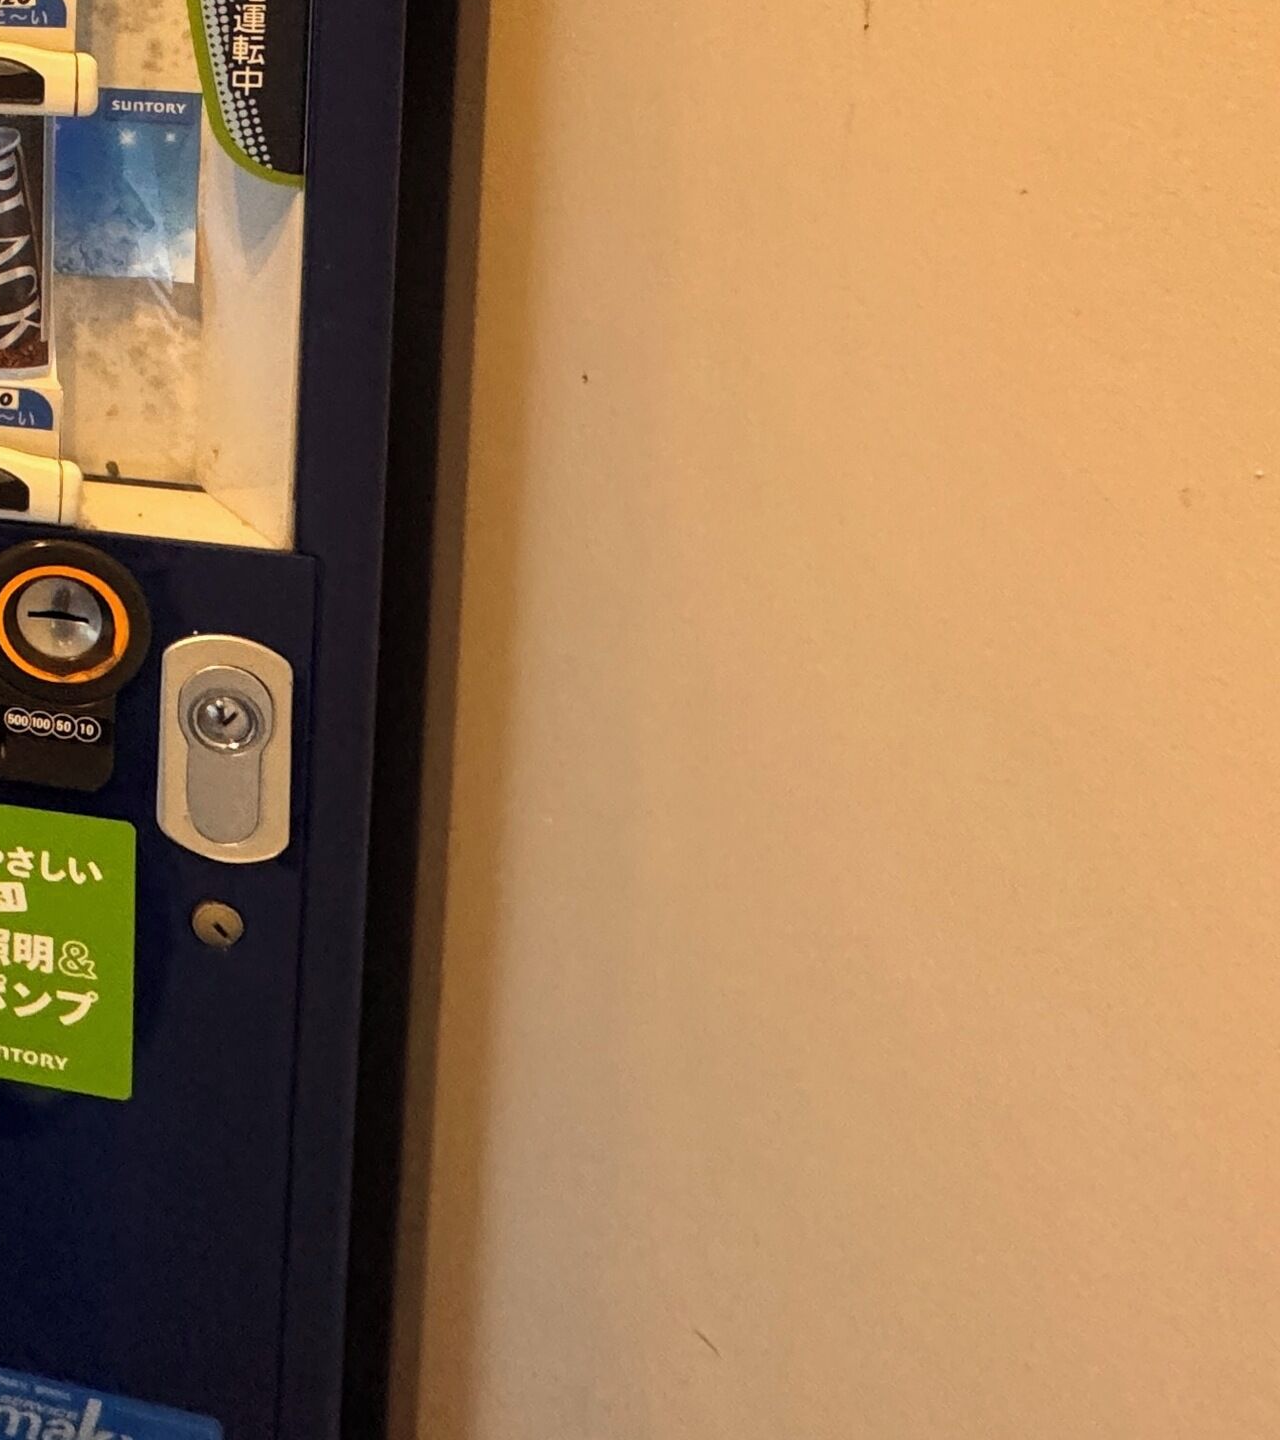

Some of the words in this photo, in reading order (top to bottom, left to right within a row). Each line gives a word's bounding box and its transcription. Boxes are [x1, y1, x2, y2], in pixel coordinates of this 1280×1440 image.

[112, 100, 187, 116] SUNTORY
[8, 713, 28, 727] 500
[32, 717, 51, 730] 100
[56, 720, 72, 732] 50
[80, 722, 94, 736] 10
